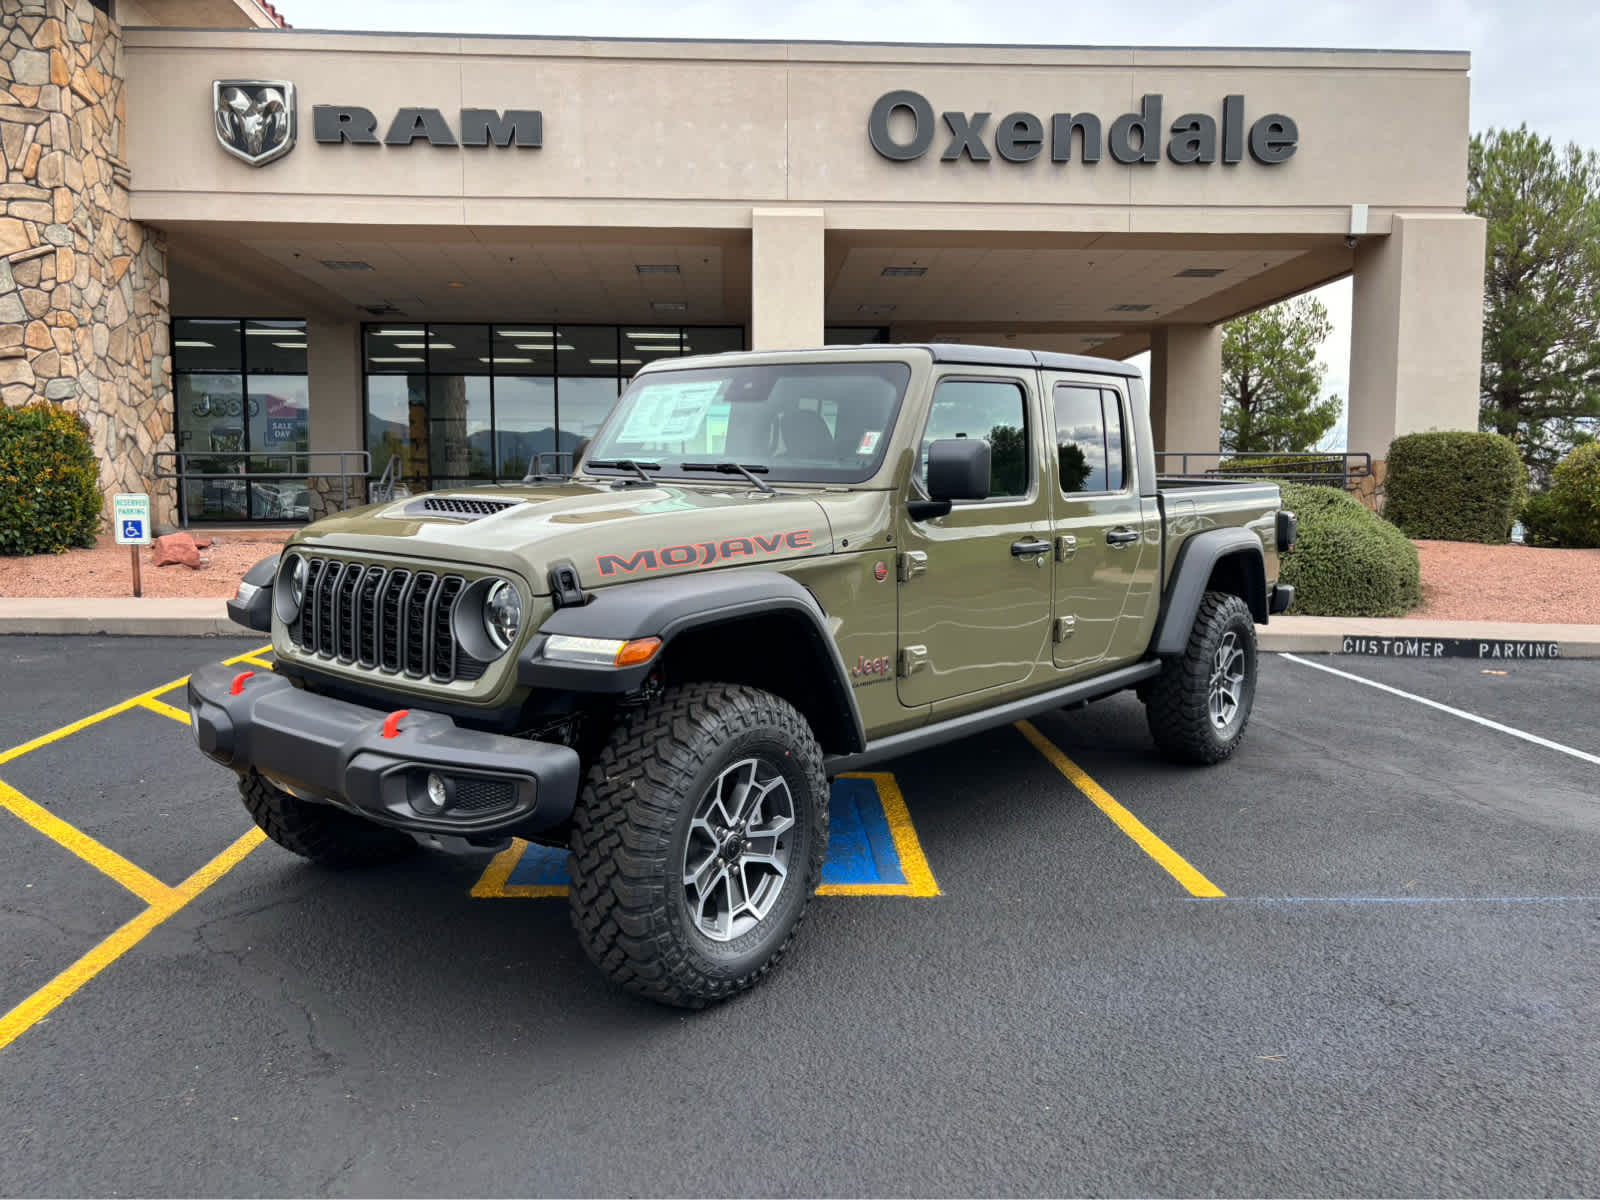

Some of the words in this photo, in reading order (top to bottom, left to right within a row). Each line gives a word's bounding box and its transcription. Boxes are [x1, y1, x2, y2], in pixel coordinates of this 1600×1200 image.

[312, 104, 543, 148] RAM
[868, 89, 1300, 165] Oxendale
[272, 422, 293, 430] SALE
[274, 430, 291, 438] DAY
[116, 499, 148, 507] RESERVED
[118, 508, 146, 516] PARKING
[596, 529, 815, 577] MOJAVE
[1343, 638, 1445, 657] CUSTOMER
[1479, 643, 1559, 658] PARKING
[851, 655, 892, 678] Jeep
